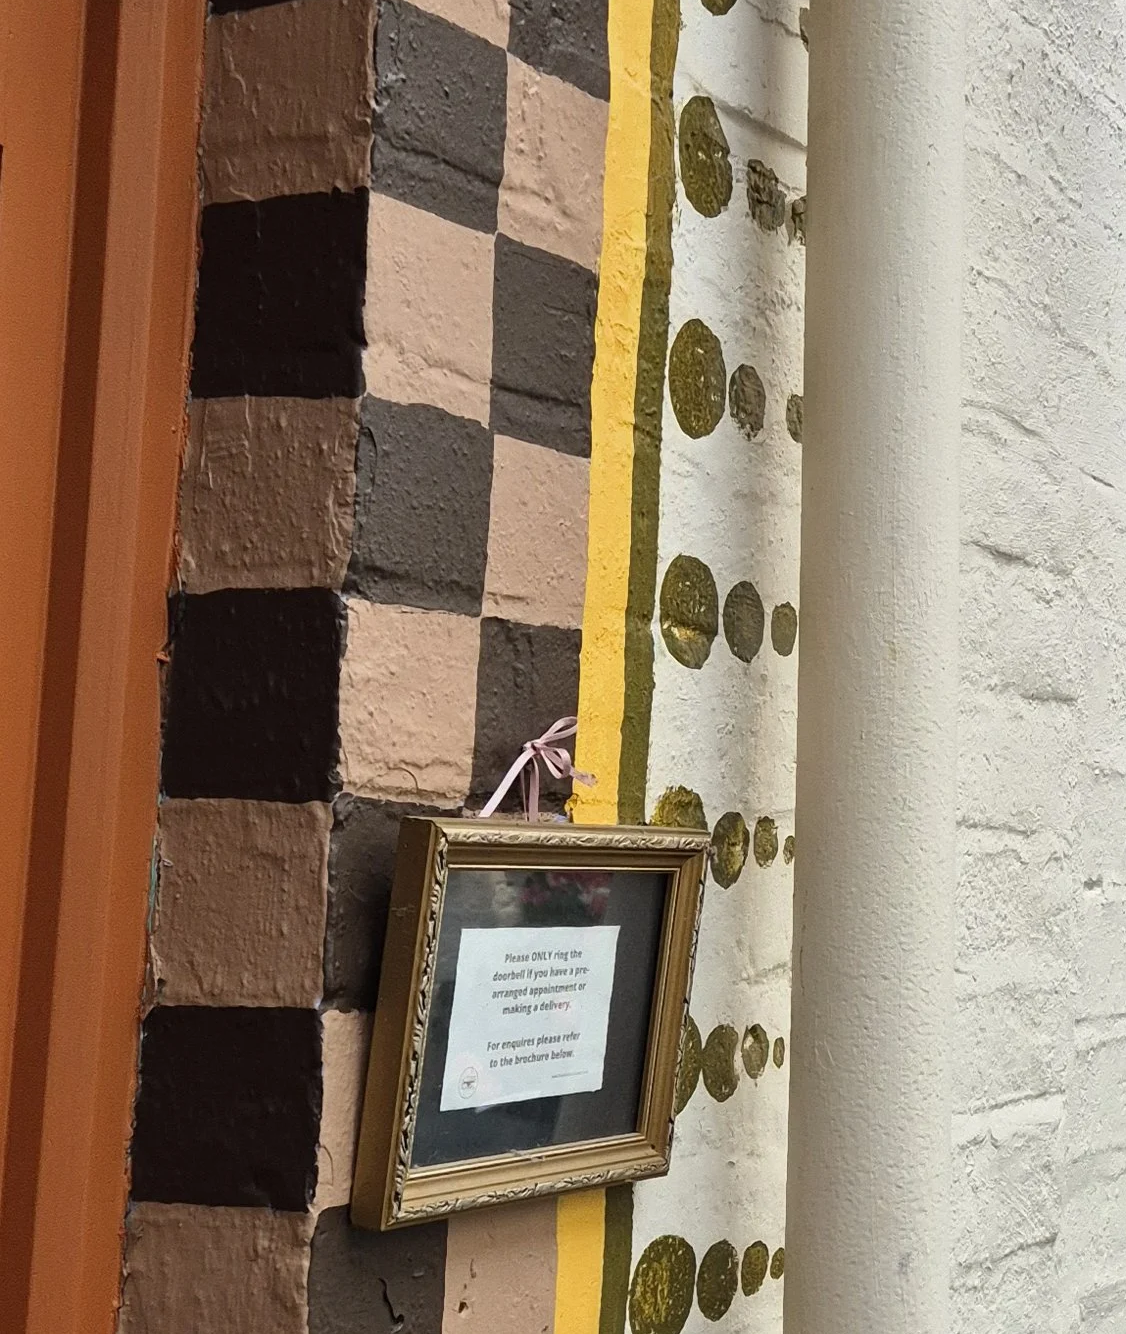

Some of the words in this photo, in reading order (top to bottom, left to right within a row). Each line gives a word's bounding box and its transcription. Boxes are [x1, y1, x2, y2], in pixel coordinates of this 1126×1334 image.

[505, 952, 529, 964] Please
[531, 951, 553, 962] ONLY
[553, 950, 568, 962] ring
[570, 949, 583, 959] the
[492, 969, 526, 982] doorbell
[526, 968, 533, 980] if
[534, 969, 548, 981] you
[549, 966, 568, 977] have
[491, 986, 528, 1000] arranged
[528, 982, 577, 998] appointment
[578, 983, 587, 991] or
[502, 1003, 532, 1016] making
[486, 1041, 501, 1052] For
[536, 1034, 561, 1048] please
[562, 1031, 581, 1042] refer
[489, 1058, 498, 1068] to
[499, 1056, 513, 1067] the
[514, 1053, 550, 1065] brochure
